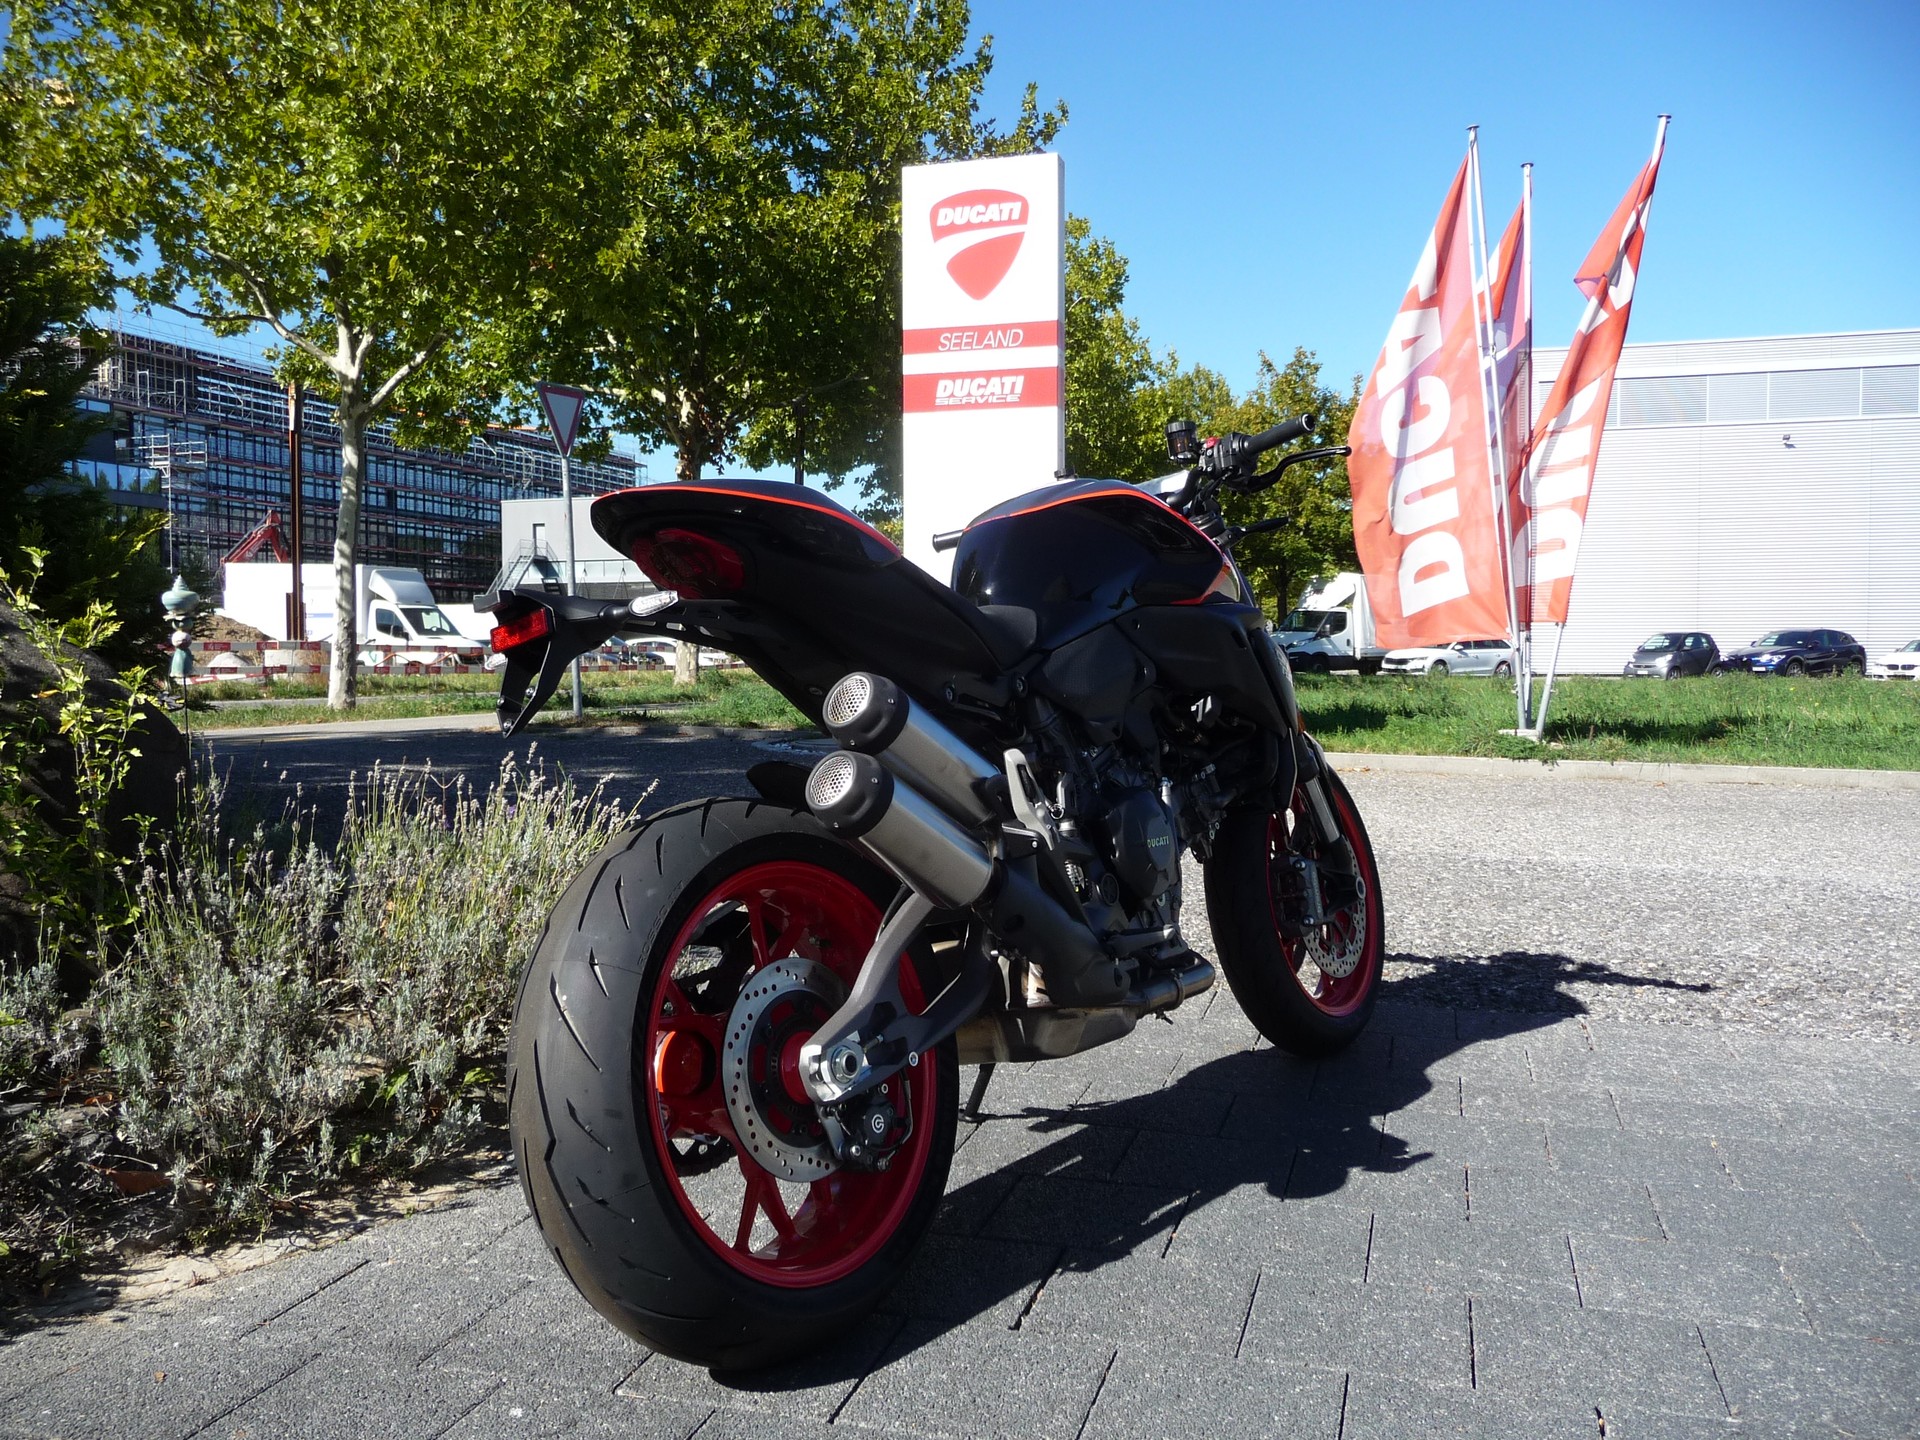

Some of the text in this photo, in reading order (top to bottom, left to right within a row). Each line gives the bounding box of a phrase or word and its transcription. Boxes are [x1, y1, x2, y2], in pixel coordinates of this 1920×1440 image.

[936, 201, 1022, 227] DUCATI
[938, 328, 1024, 351] SEELAND
[935, 375, 1025, 398] DUCATI
[935, 393, 1021, 406] SERVICE
[1147, 836, 1169, 848] DUCATI
[637, 904, 670, 966] ROSSO
